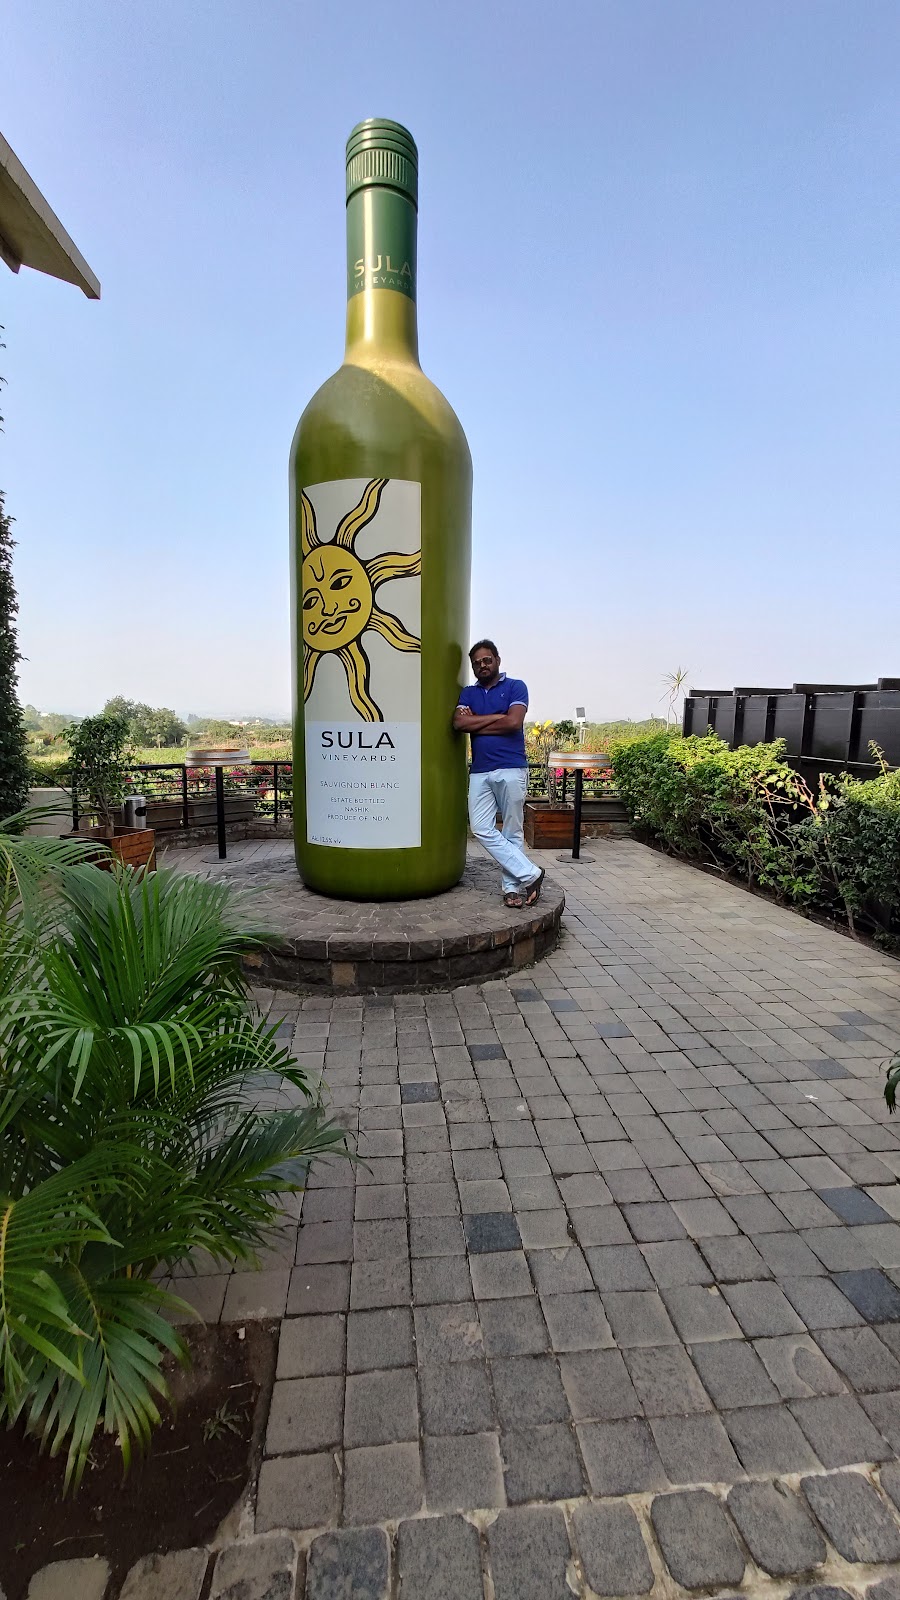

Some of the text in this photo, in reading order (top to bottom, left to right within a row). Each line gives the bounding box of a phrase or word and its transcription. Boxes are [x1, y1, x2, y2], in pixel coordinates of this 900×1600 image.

[354, 254, 412, 279] SULA
[321, 730, 396, 749] SULA
[321, 754, 396, 762] VINEYARDS
[320, 780, 367, 789] SAUVIGNON
